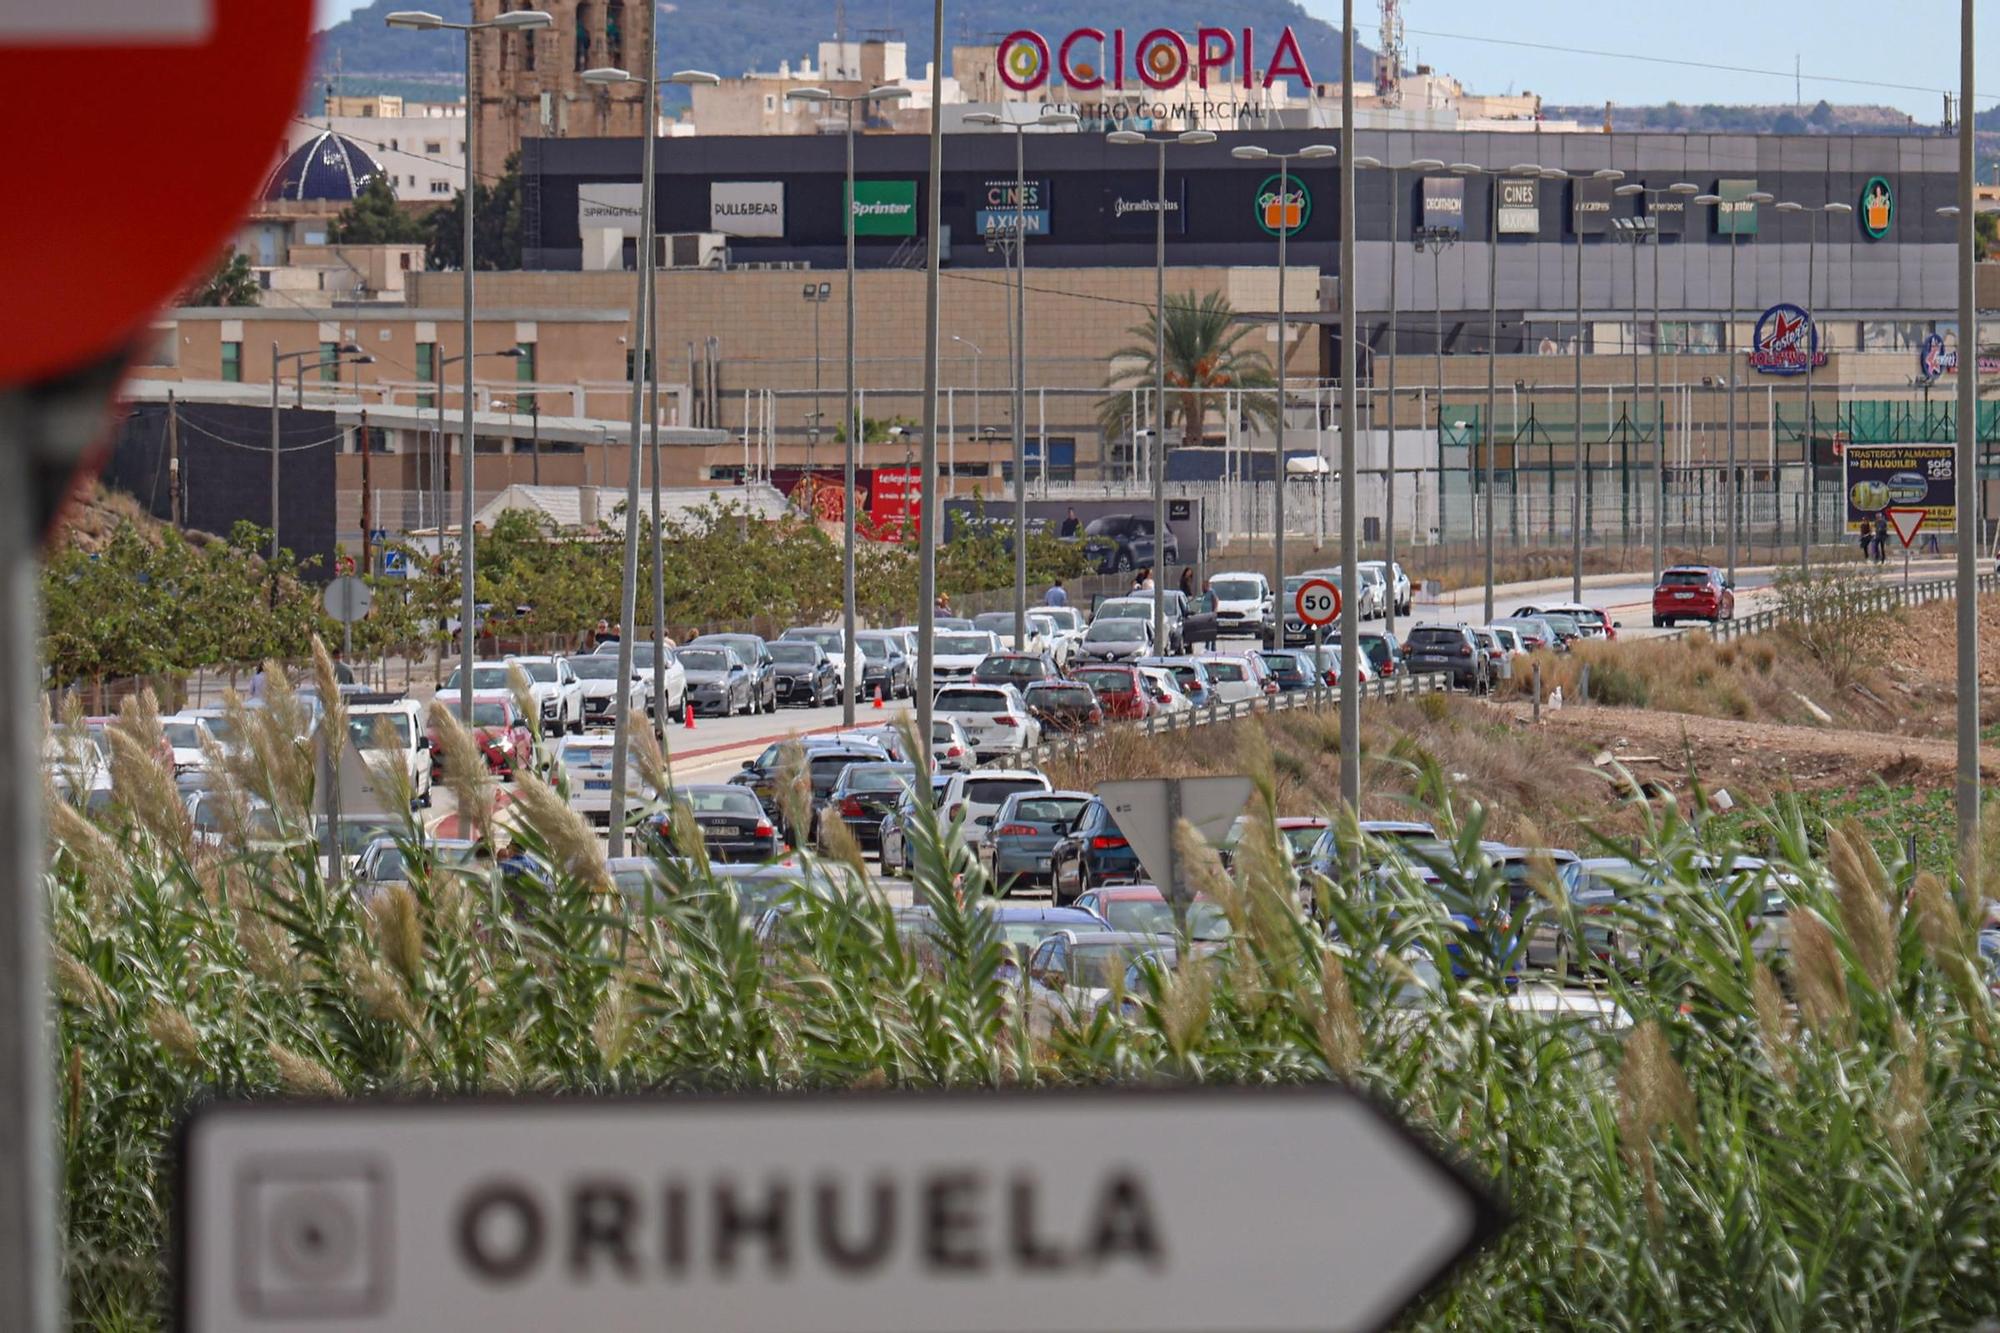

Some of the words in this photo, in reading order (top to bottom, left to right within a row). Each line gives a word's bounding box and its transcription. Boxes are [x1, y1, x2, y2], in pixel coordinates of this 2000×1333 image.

[996, 26, 1314, 91] OCIOPIA
[1040, 102, 1129, 121] CENTRO
[1136, 101, 1265, 120] COMERCIAL
[988, 187, 1038, 205] CINES
[1504, 186, 1534, 203] CINES
[715, 203, 778, 215] PULL&BEAR
[852, 201, 911, 216] Sprinter
[1850, 450, 1897, 458] TRASTEROS
[1898, 450, 1904, 458] Y
[1904, 449, 1952, 458] ALMACENES
[1860, 460, 1872, 469] EN
[1873, 460, 1917, 469] ALQUILER
[1305, 595, 1331, 610] 50
[455, 1166, 1168, 1288] ORIHUELA
